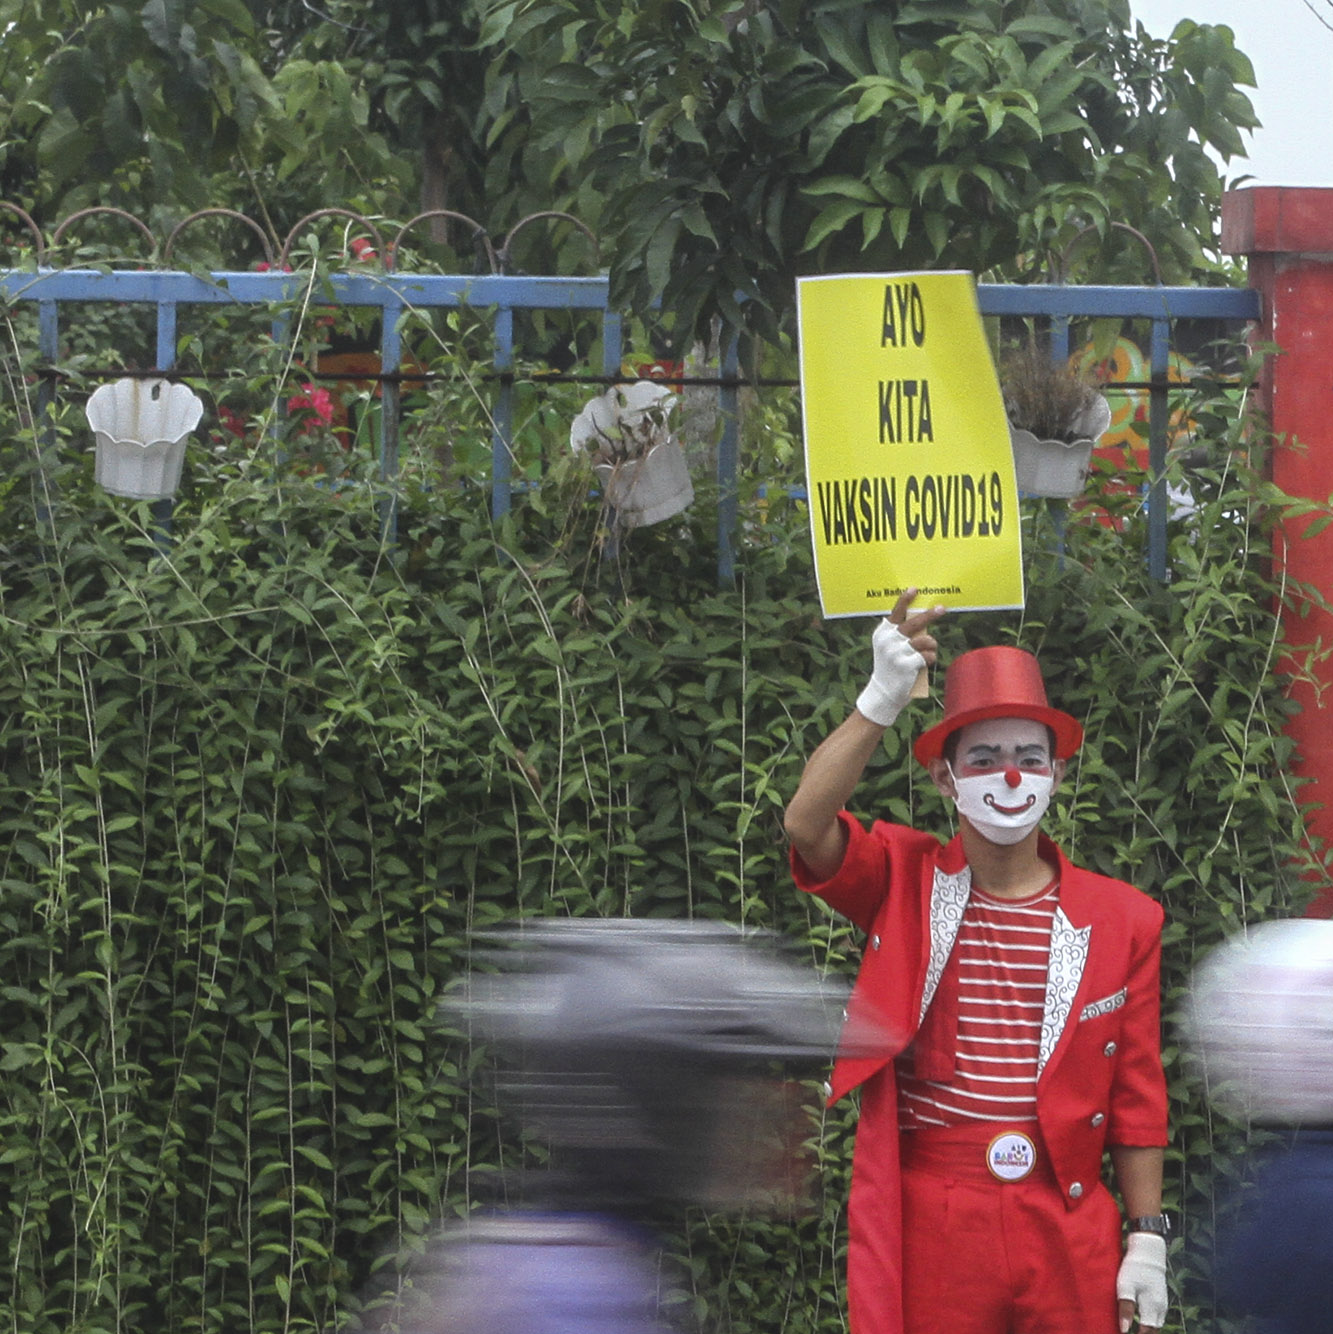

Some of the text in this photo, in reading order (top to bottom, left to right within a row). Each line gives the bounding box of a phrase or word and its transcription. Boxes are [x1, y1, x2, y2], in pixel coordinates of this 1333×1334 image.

[881, 281, 925, 348] AYO
[878, 379, 934, 444] KITA
[817, 471, 1003, 546] VAKSIN COVID19
[866, 588, 881, 598] Aku
[914, 585, 961, 595] ndonesia
